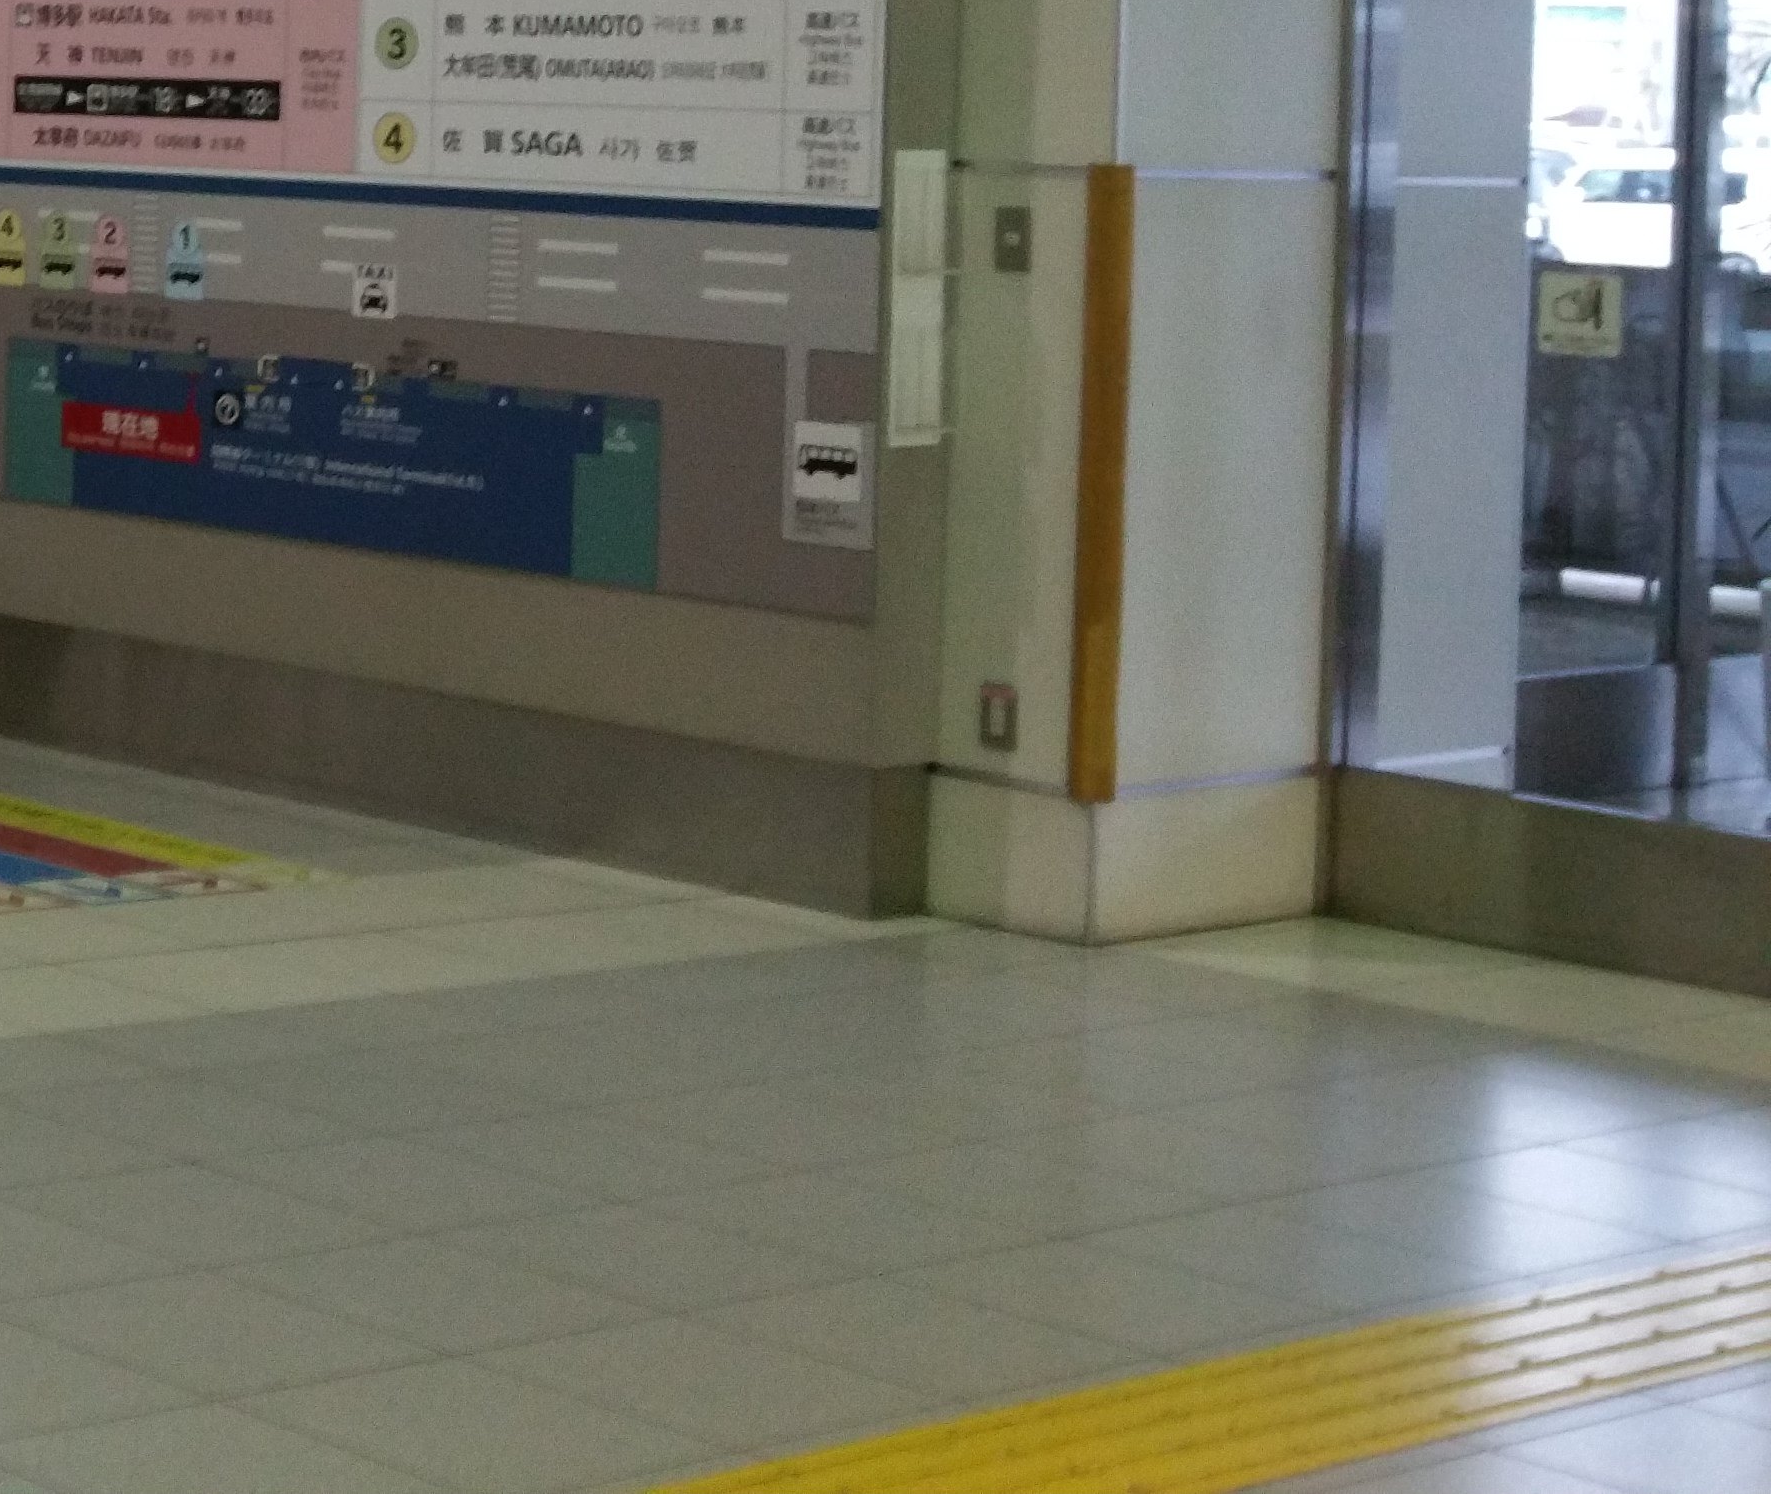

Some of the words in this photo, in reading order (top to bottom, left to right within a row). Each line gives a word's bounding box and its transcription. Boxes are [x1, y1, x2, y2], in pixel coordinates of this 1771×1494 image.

[511, 13, 644, 38] KUMAMOTO
[389, 28, 407, 60] 3
[383, 123, 403, 154] 4
[510, 130, 584, 158] SAGA
[0, 215, 15, 237] 4
[52, 217, 66, 241] 3
[104, 220, 118, 244] 2
[179, 224, 191, 250] 1
